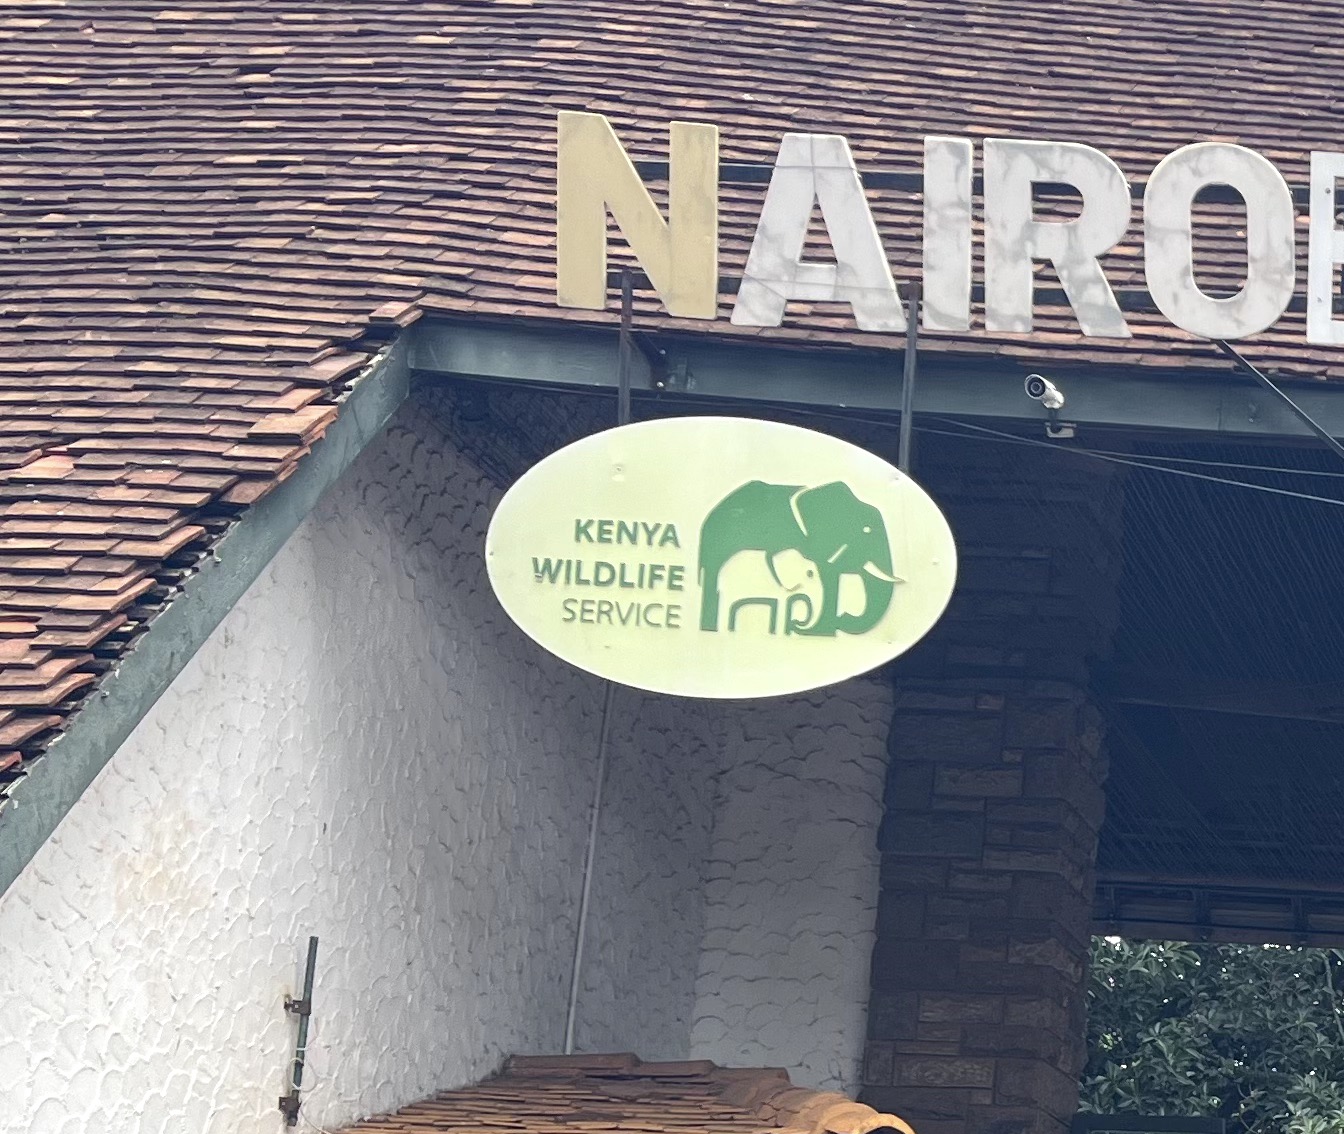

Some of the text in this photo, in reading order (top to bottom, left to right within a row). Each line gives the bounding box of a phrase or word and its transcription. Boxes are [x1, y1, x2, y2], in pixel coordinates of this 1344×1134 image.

[574, 518, 680, 548] KENYA
[531, 557, 685, 591] WILDLIFE
[561, 598, 682, 629] SERVICE
